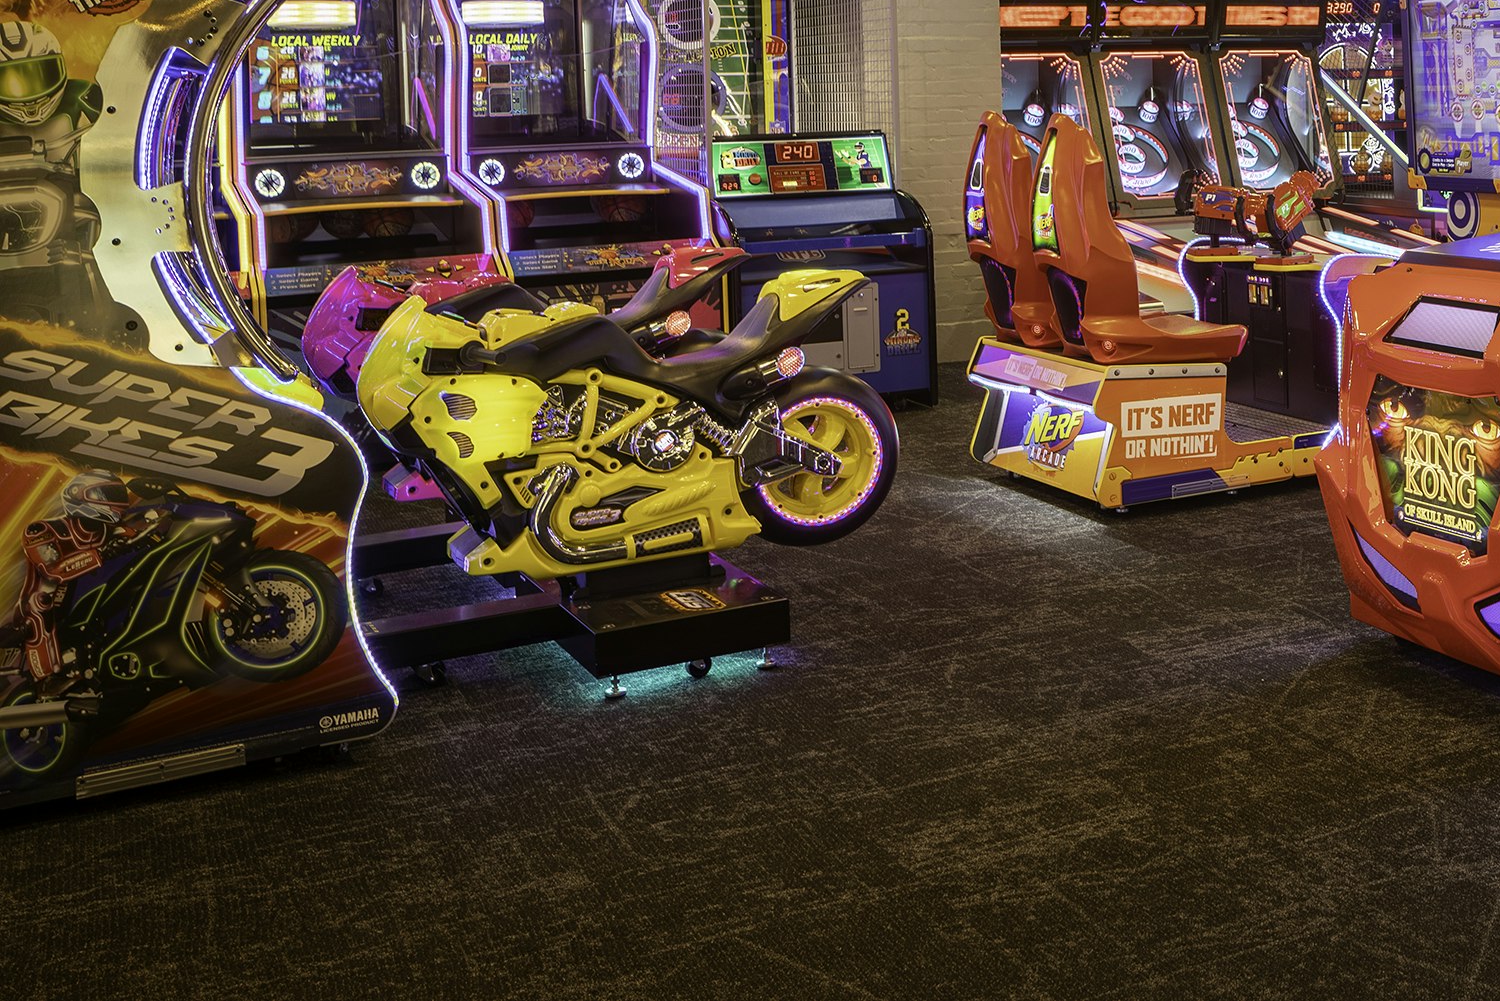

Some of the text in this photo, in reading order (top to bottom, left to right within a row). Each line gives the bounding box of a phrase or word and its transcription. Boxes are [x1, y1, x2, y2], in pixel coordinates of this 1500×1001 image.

[271, 34, 361, 48] LOCAL WEEKLY
[469, 33, 538, 45] LOCAL DAILY
[474, 67, 482, 77] 0
[782, 144, 813, 159] 240
[1205, 193, 1216, 202] P1
[1281, 204, 1290, 213] P2
[896, 308, 910, 331] 2
[0, 350, 273, 437] SUPER
[1127, 402, 1216, 431] IT'S NERF
[0, 391, 235, 467] BIKES
[1024, 410, 1084, 446] NERF
[1125, 434, 1214, 459] OR NOTHIN'!
[1404, 426, 1477, 477] KING
[1029, 447, 1067, 469] ARCADE
[1404, 461, 1477, 509] KONG
[1404, 503, 1416, 516] OF
[1416, 505, 1444, 525] SKULL
[1444, 513, 1476, 533] ISLAND
[319, 718, 379, 734] LICENSED PRODUCT
[333, 708, 380, 726] YAMAHA
